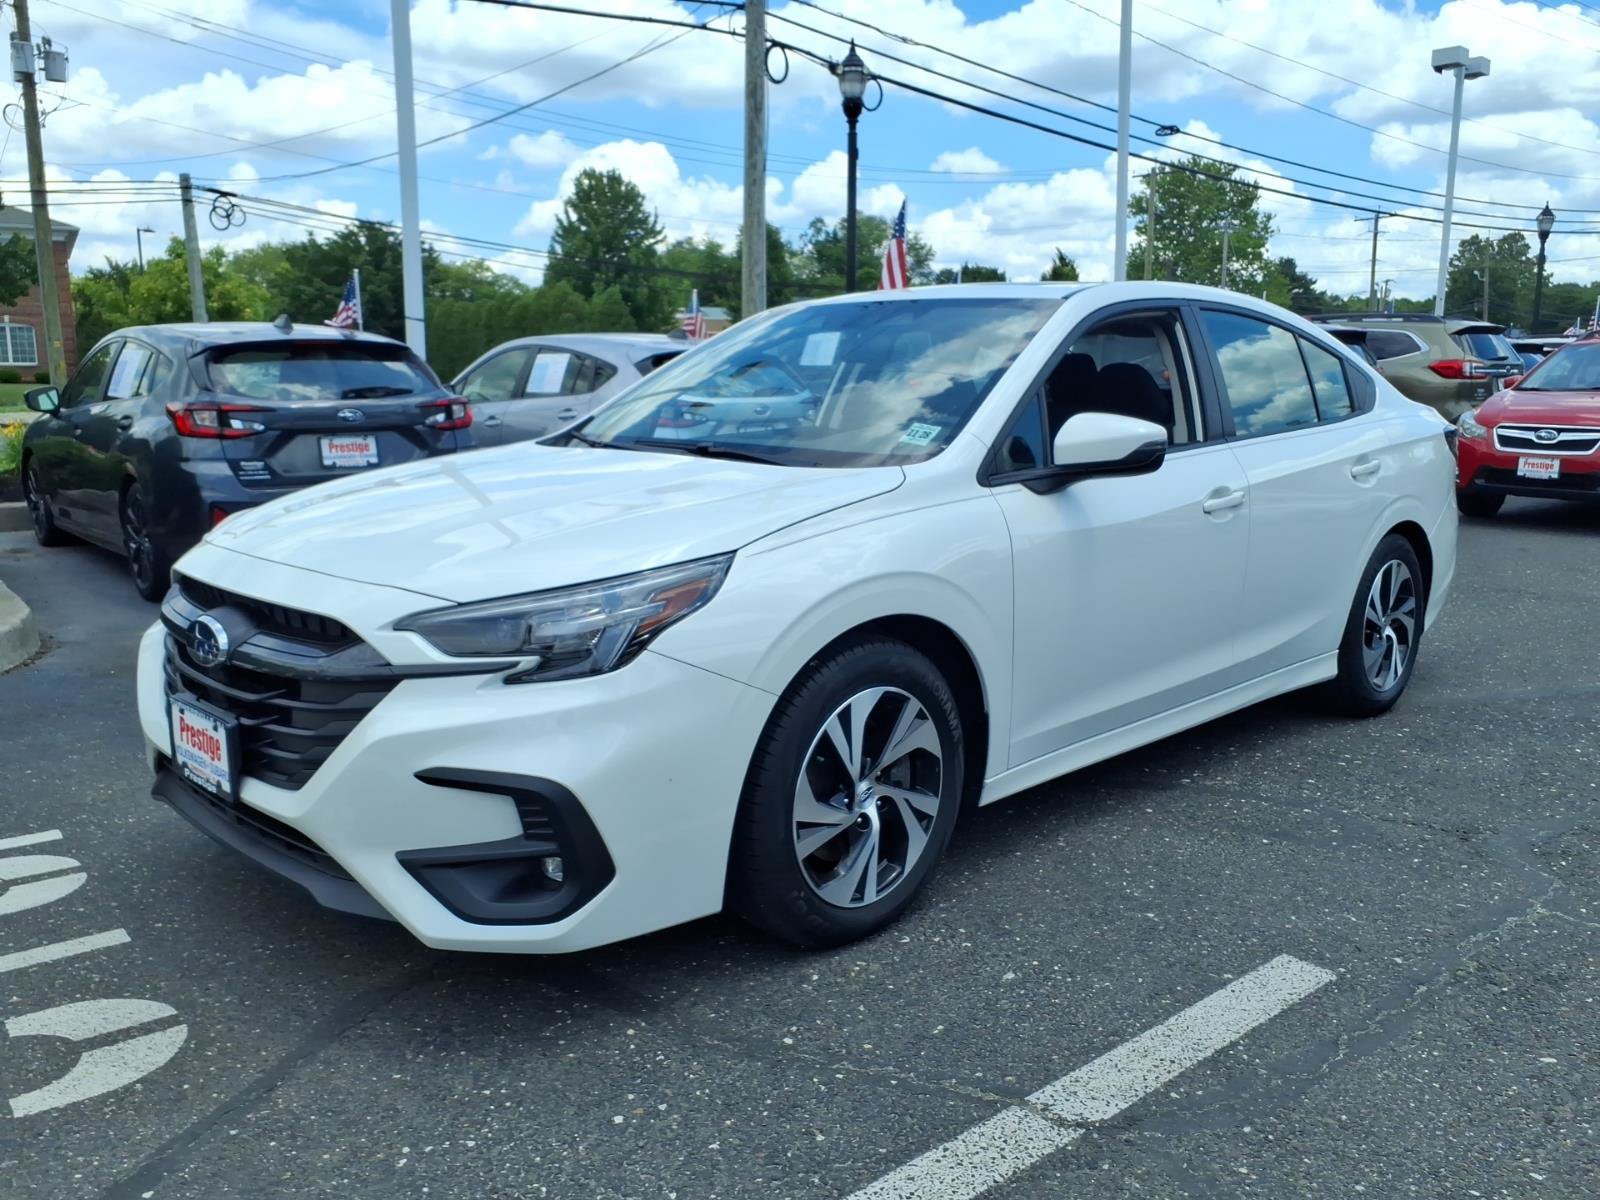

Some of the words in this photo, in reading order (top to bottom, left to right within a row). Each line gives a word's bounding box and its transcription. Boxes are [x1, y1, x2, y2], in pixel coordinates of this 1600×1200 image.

[328, 441, 370, 454] Prestige
[1523, 461, 1555, 471] Prestige
[179, 715, 222, 762] Prestige
